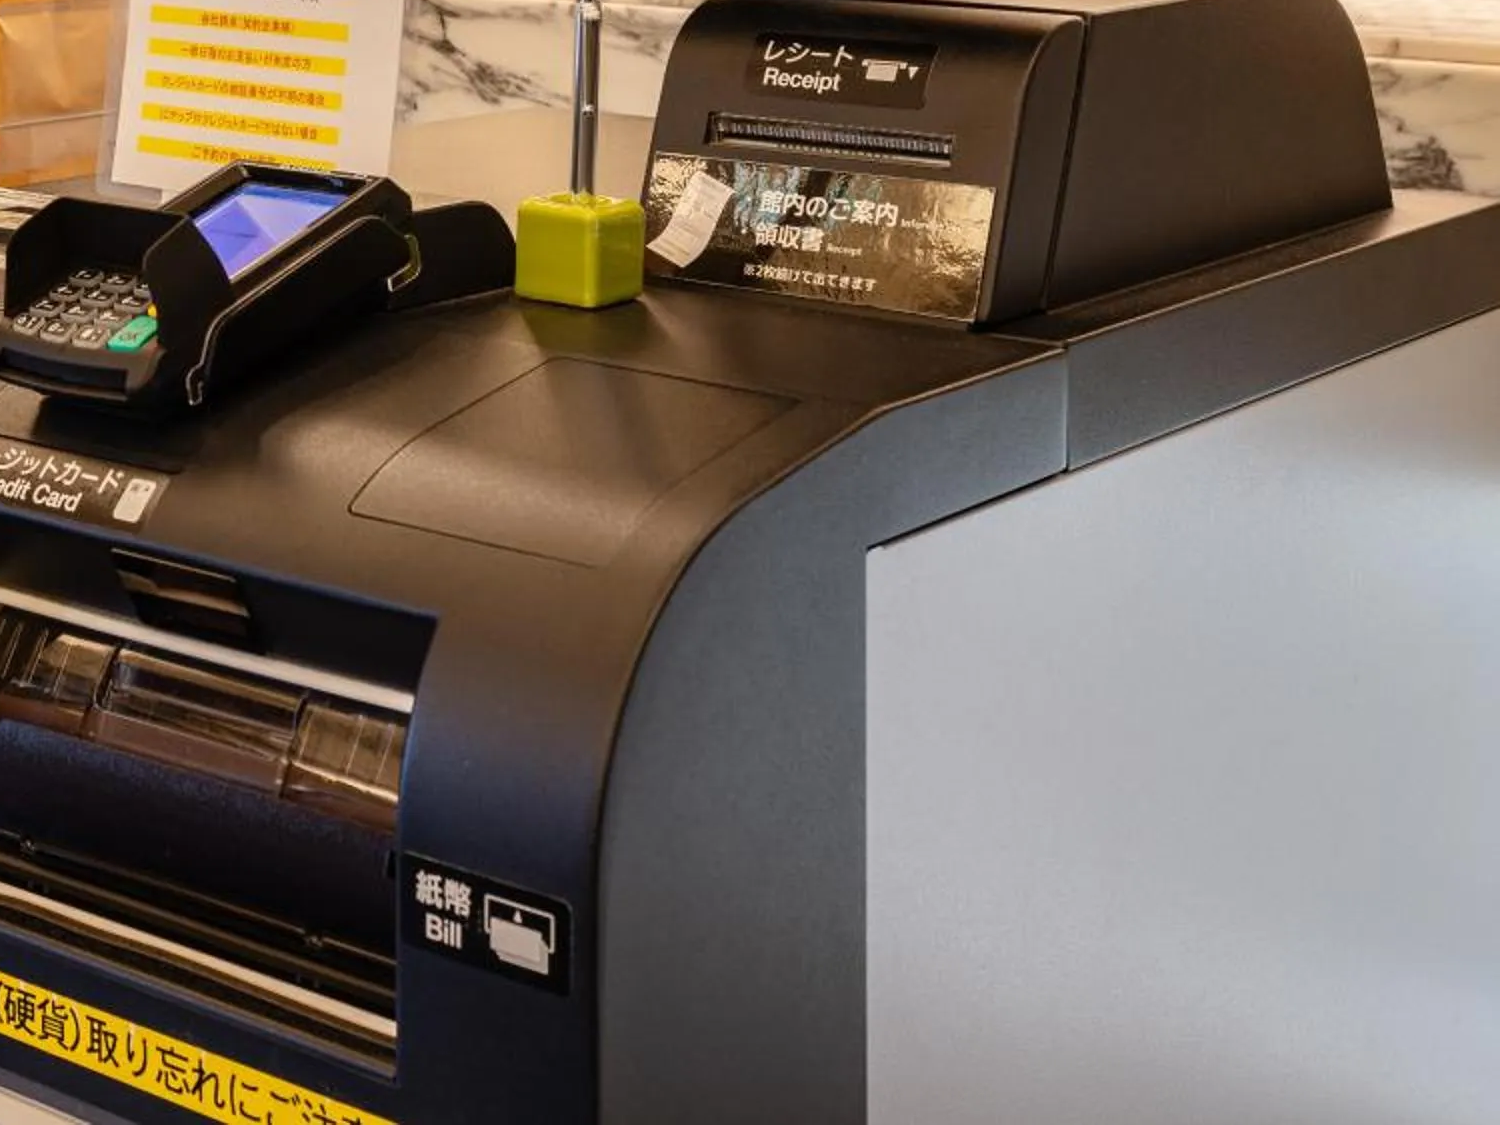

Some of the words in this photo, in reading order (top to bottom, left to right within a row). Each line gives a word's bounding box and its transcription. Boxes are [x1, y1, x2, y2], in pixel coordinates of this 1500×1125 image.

[763, 39, 855, 68] レシート
[762, 66, 843, 95] Receipt
[758, 189, 900, 227] 館内のご案内
[754, 222, 825, 253] 領収書
[32, 483, 83, 513] Card
[415, 868, 472, 919] 紙幣
[425, 911, 463, 950] Bill
